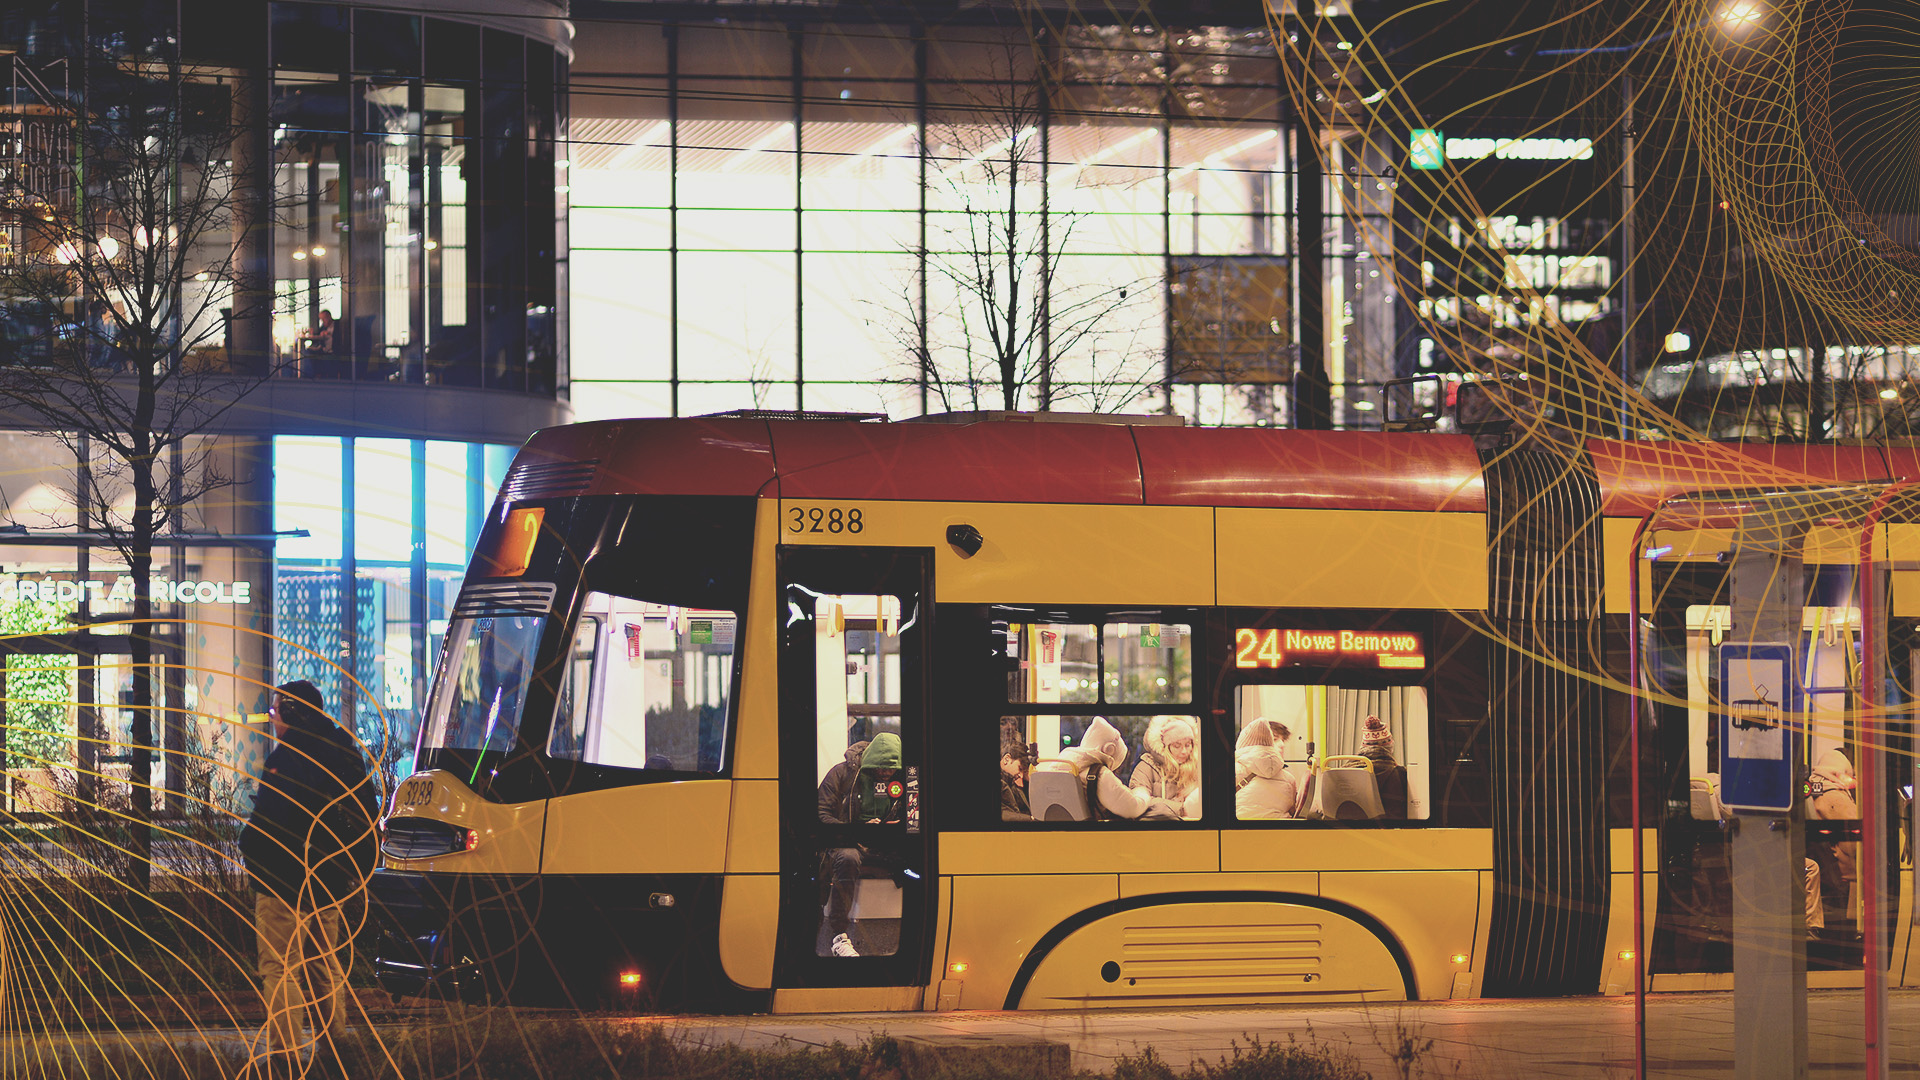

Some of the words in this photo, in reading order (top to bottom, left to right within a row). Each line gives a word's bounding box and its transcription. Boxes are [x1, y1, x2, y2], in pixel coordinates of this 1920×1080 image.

[788, 507, 864, 534] 3288
[1236, 628, 1281, 668] 24
[1286, 630, 1336, 650] Nowe
[1340, 631, 1417, 651] Bemowo
[404, 780, 434, 806] 3288
